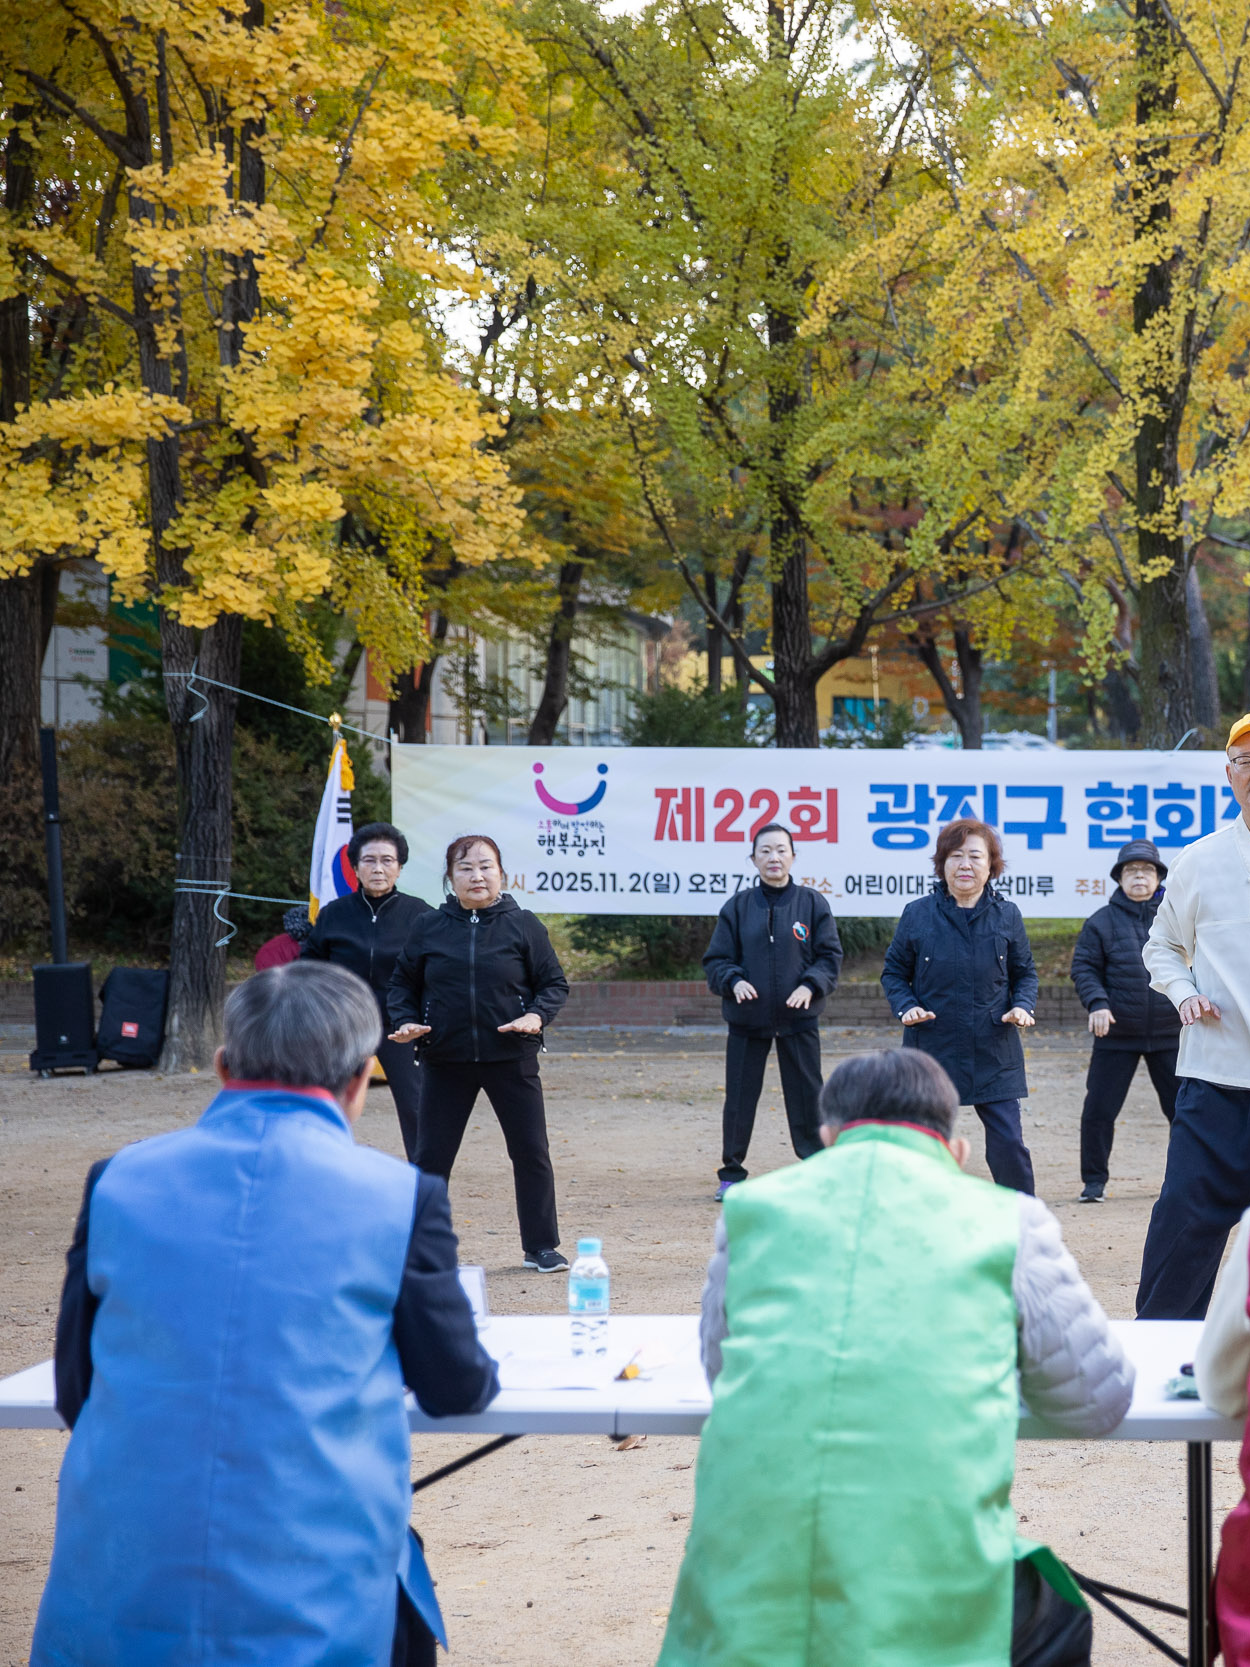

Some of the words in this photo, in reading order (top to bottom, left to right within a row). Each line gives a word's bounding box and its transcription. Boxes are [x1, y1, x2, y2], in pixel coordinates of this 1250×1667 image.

[654, 786, 839, 844] 제22회
[867, 784, 1067, 850] 광진구
[536, 832, 605, 857] 행복광진
[687, 872, 727, 894] 오전
[994, 874, 1055, 896] 싹마루
